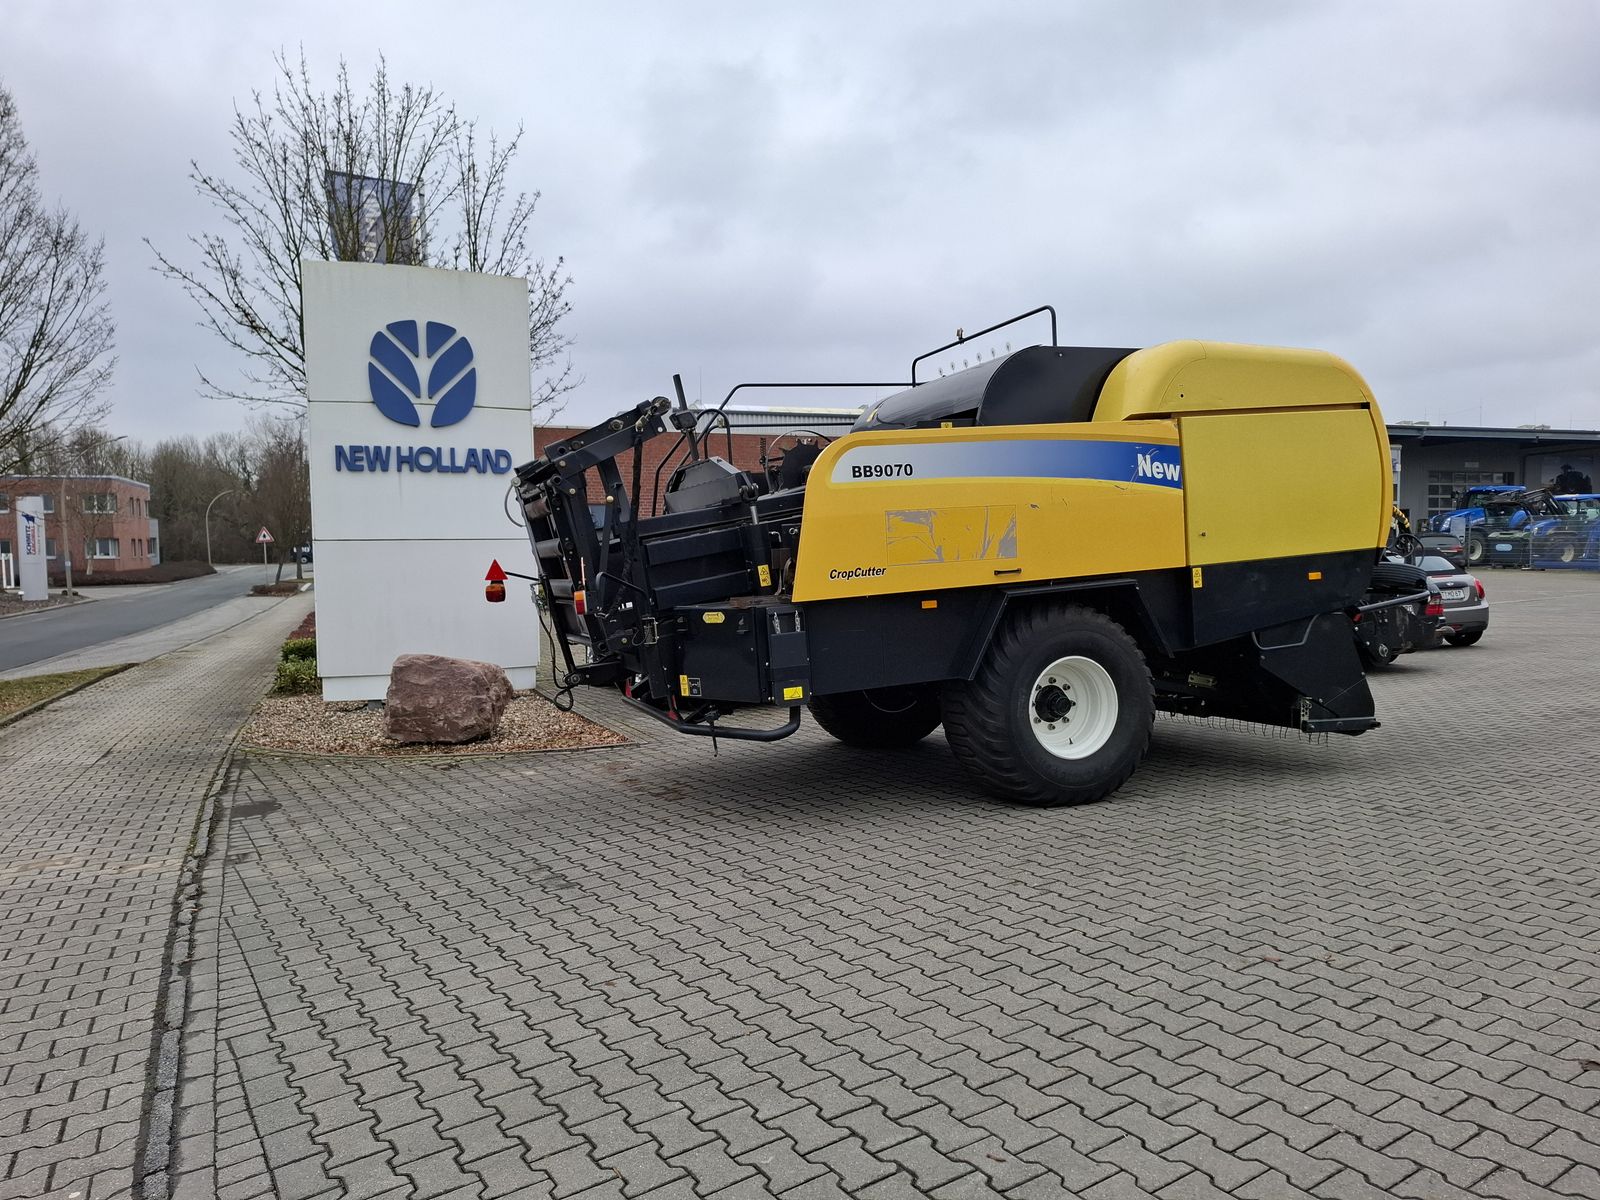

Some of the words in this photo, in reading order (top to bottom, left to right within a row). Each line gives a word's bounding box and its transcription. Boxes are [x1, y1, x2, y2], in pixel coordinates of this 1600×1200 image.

[335, 445, 391, 472] NEW
[397, 446, 512, 474] HOLLAND
[1137, 453, 1180, 481] New
[852, 464, 913, 478] BB9070
[830, 566, 886, 580] CropCutter
